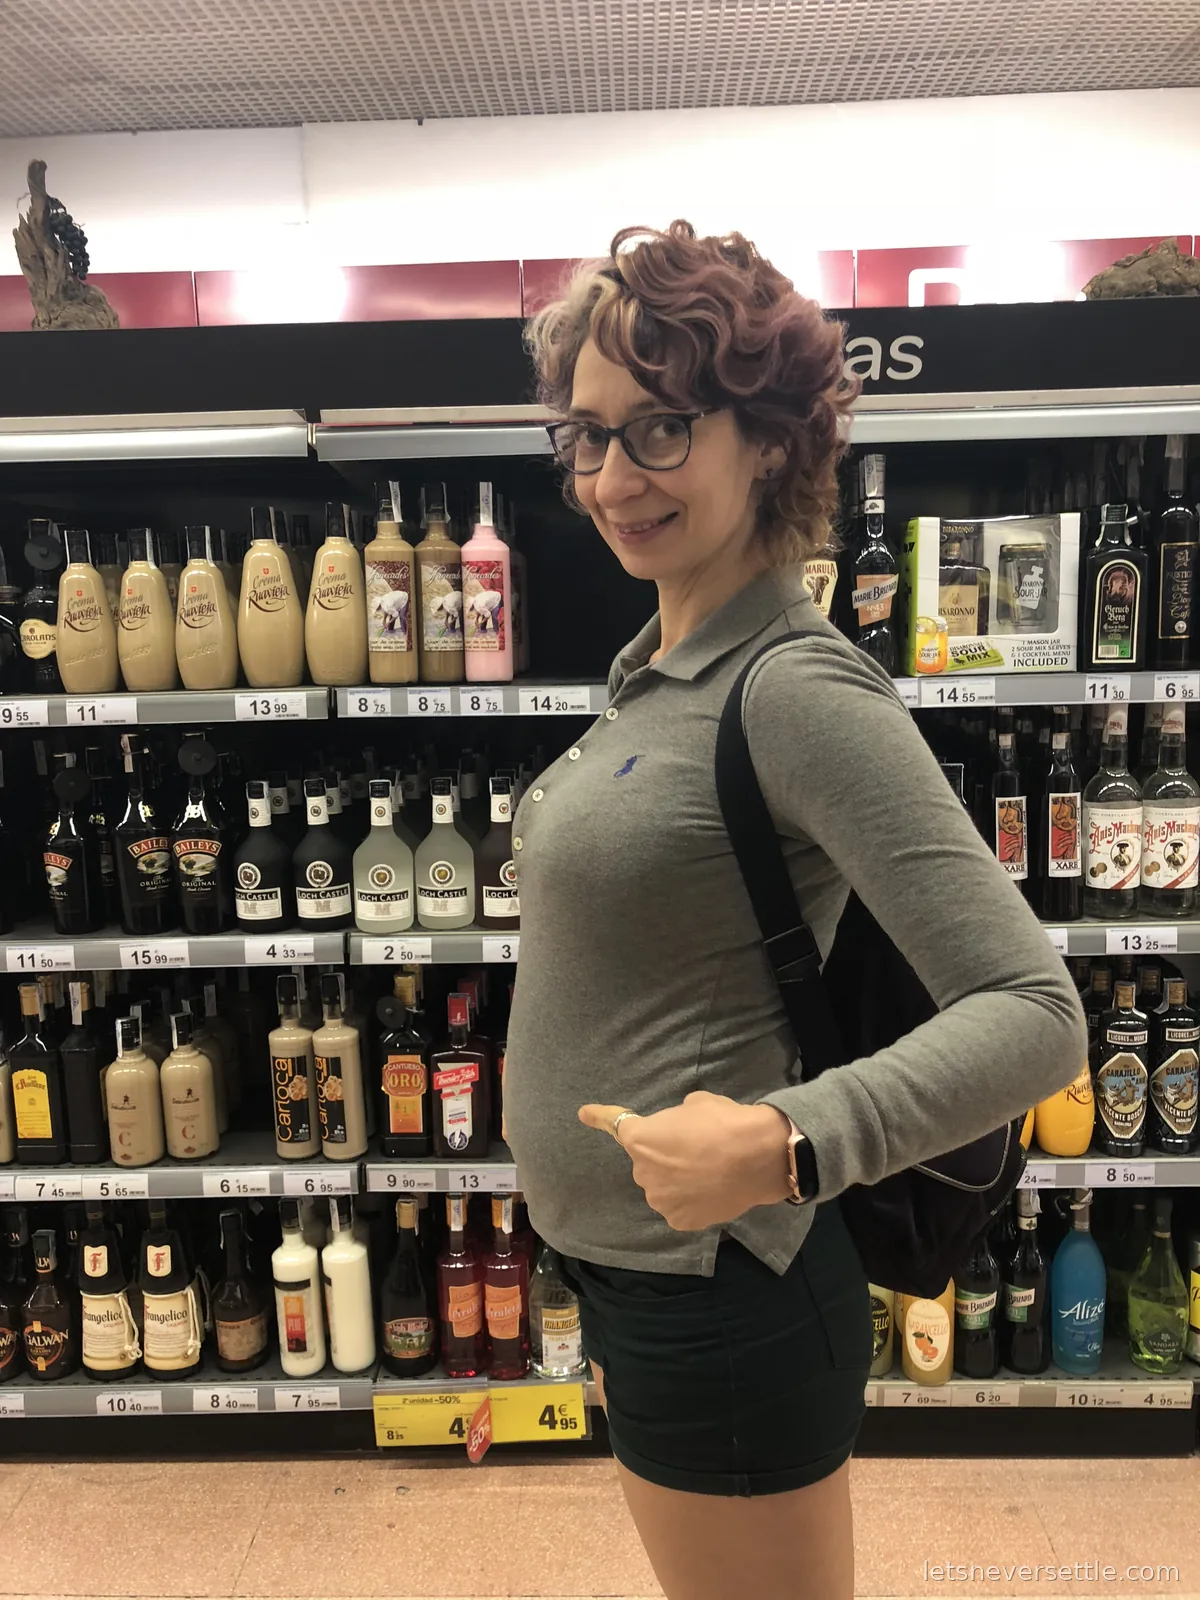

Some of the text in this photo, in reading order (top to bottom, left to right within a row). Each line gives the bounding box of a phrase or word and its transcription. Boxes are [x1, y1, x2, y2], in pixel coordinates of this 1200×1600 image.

[803, 563, 836, 578] MARULA
[854, 591, 872, 604] MARIE
[951, 646, 986, 658] SOUR
[966, 651, 990, 662] MIX
[1013, 657, 1068, 667] INCLUDED
[936, 688, 975, 702] 14 55
[1088, 683, 1124, 699] 11 30
[1165, 683, 1175, 697] 6
[249, 700, 287, 716] 13 99
[358, 698, 385, 712] 8 75
[418, 697, 446, 711] 8 75
[471, 696, 498, 710] 8 75
[530, 696, 568, 711] 14 20
[1, 708, 29, 723] 9 55
[77, 706, 96, 721] 11
[175, 842, 217, 853] BAILEYS
[319, 888, 348, 898] CASTLE
[380, 893, 408, 902] CASTLE
[437, 889, 466, 898] CASTLE
[1121, 935, 1158, 950] 13 25
[131, 950, 167, 965] 15 99
[266, 944, 295, 958] 4 33
[384, 946, 413, 960] 2 50
[502, 945, 511, 958] 3
[17, 952, 53, 968] 11 50
[389, 1073, 421, 1087] ORO
[275, 1058, 292, 1141] Carioca
[387, 1175, 415, 1188] 9 90
[459, 1175, 479, 1188] 13
[1107, 1168, 1135, 1182] 8 50
[35, 1183, 64, 1196] 7 45
[100, 1183, 127, 1196] 5 65
[220, 1180, 230, 1193] 6
[304, 1179, 333, 1192] 6 95
[90, 1252, 102, 1272] F
[154, 1252, 166, 1272] F
[211, 1394, 220, 1408] 8
[292, 1395, 301, 1407] 7
[902, 1393, 911, 1404] 7
[976, 1392, 985, 1403] 6
[1069, 1394, 1088, 1405] 10
[1144, 1394, 1154, 1405] 4
[108, 1398, 126, 1412] 10
[539, 1404, 577, 1430] 4 € 95
[449, 1417, 465, 1438] 4
[387, 1430, 394, 1440] 8
